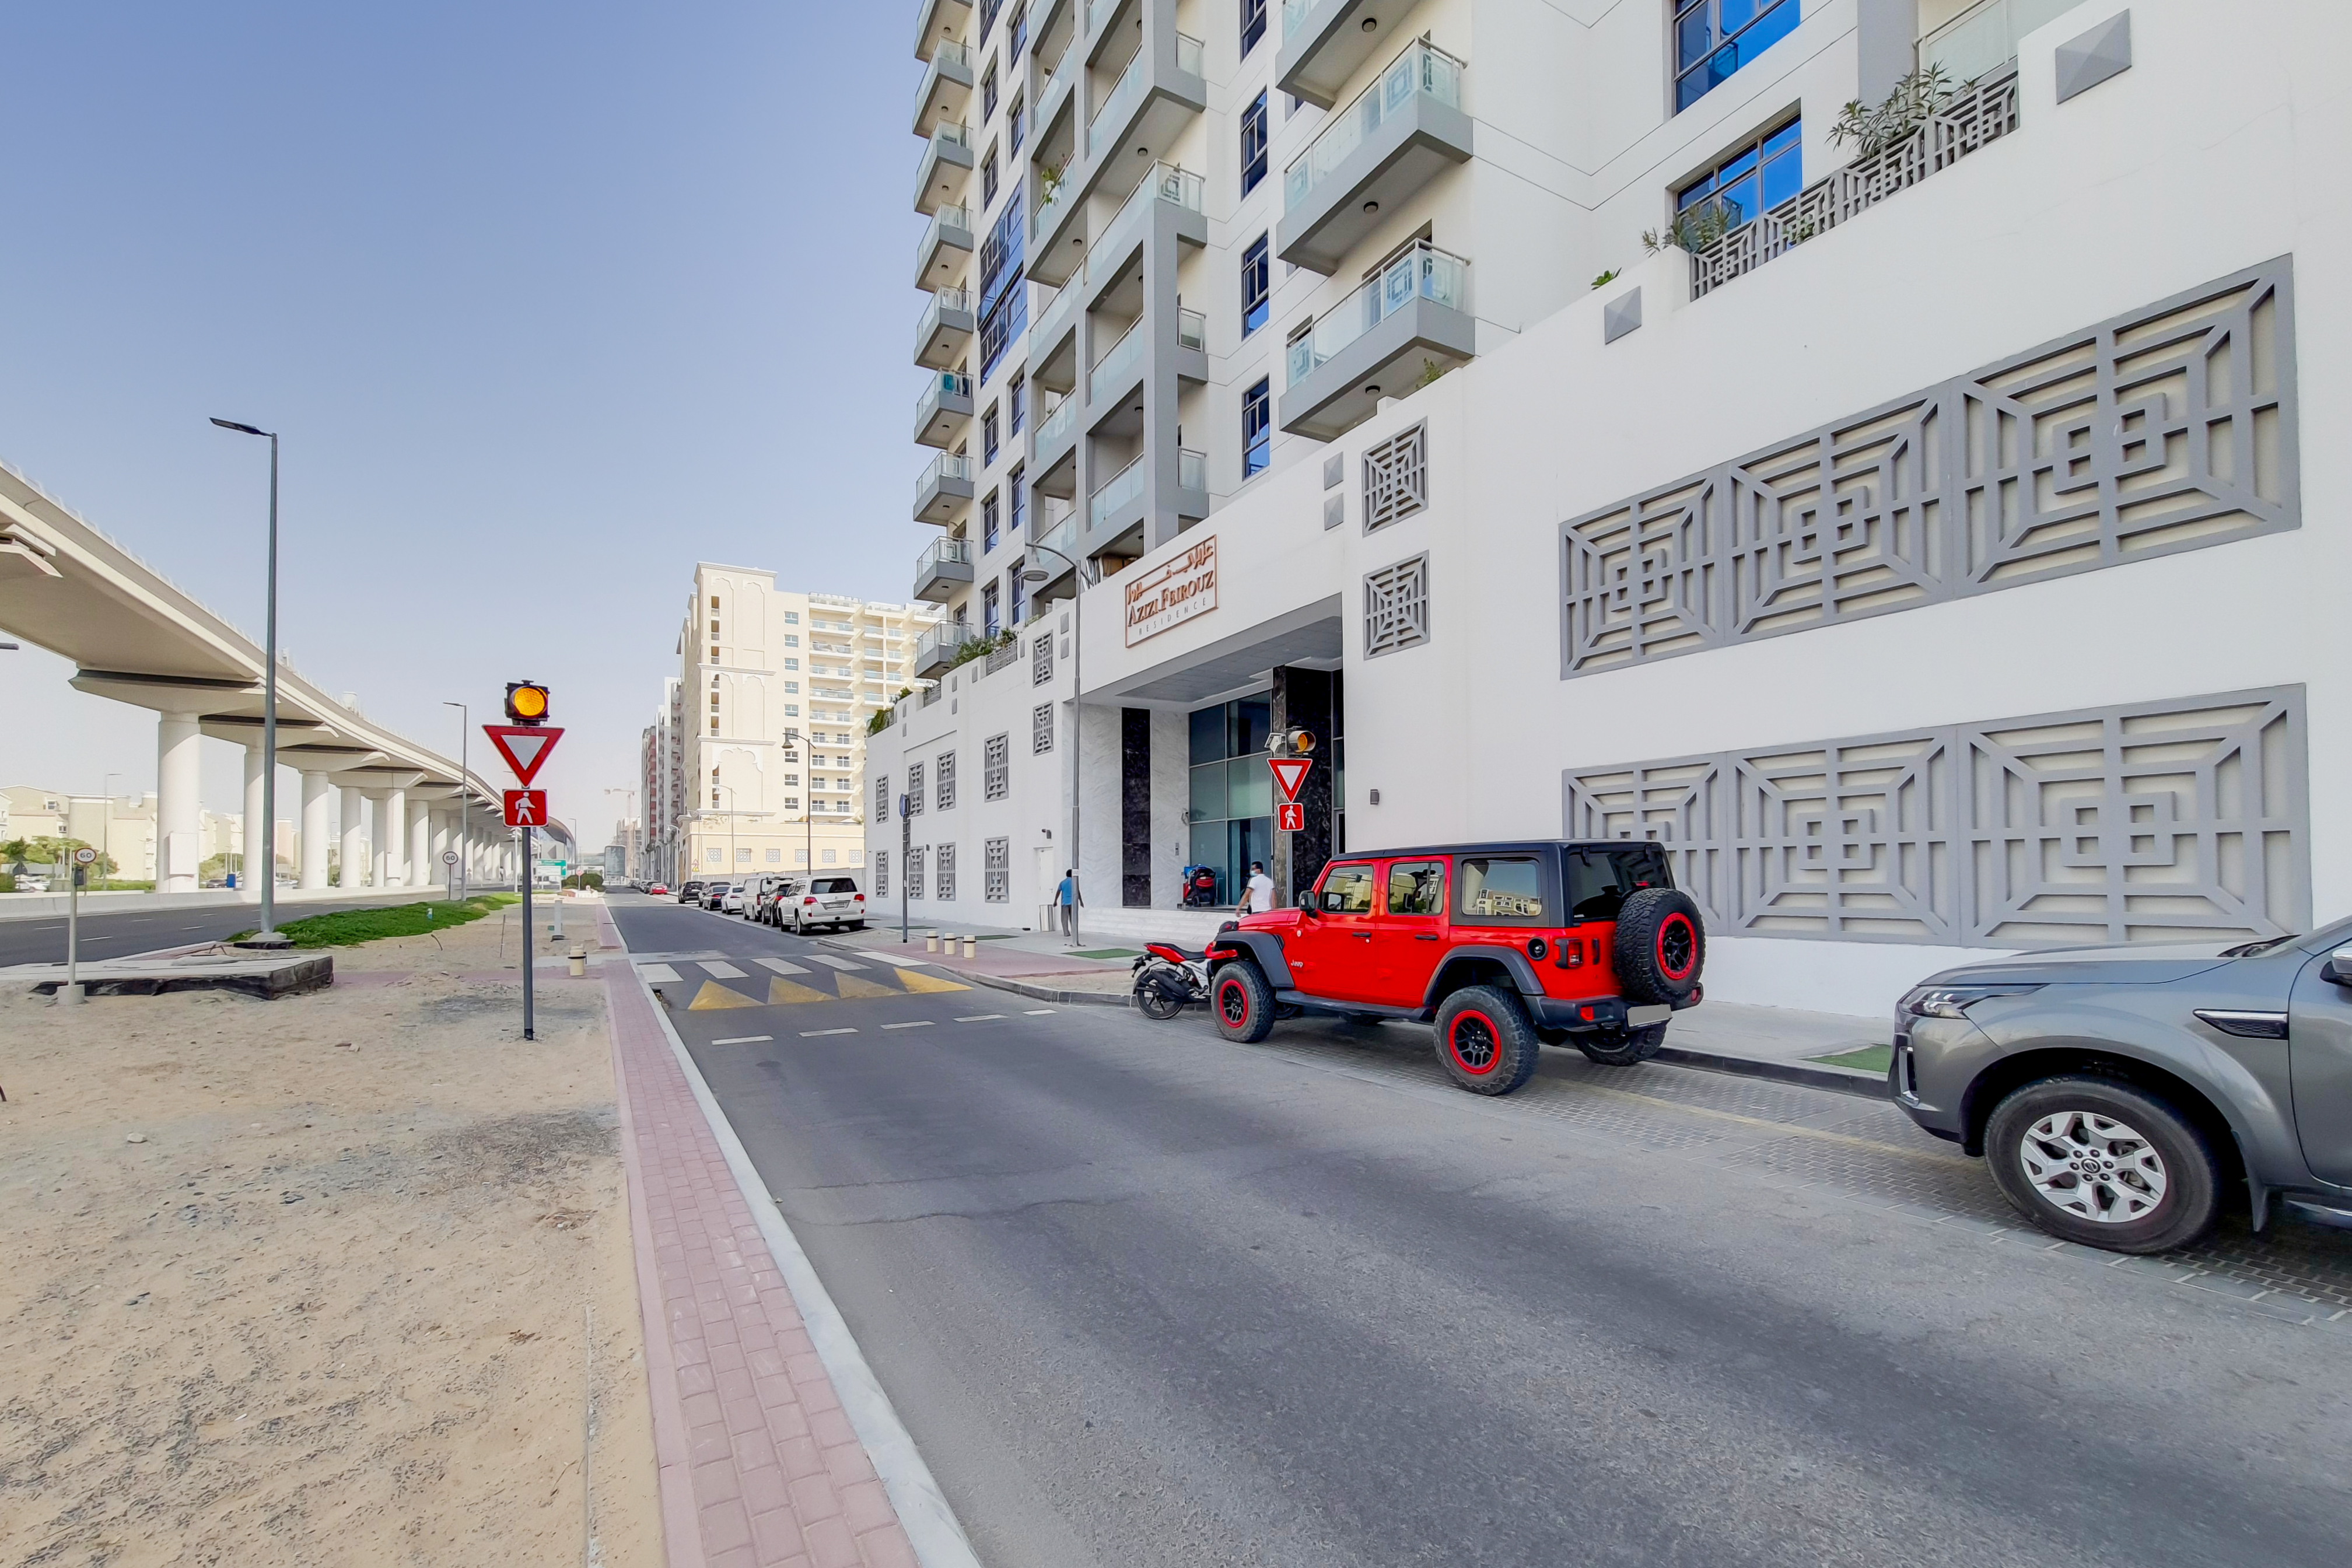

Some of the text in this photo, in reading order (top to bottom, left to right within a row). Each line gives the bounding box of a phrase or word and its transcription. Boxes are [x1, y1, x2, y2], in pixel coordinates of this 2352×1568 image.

[1128, 570, 1214, 627] AZIZI FEIROUZ
[1139, 597, 1206, 635] RESIDENCE
[1290, 959, 1304, 968] Jeep
